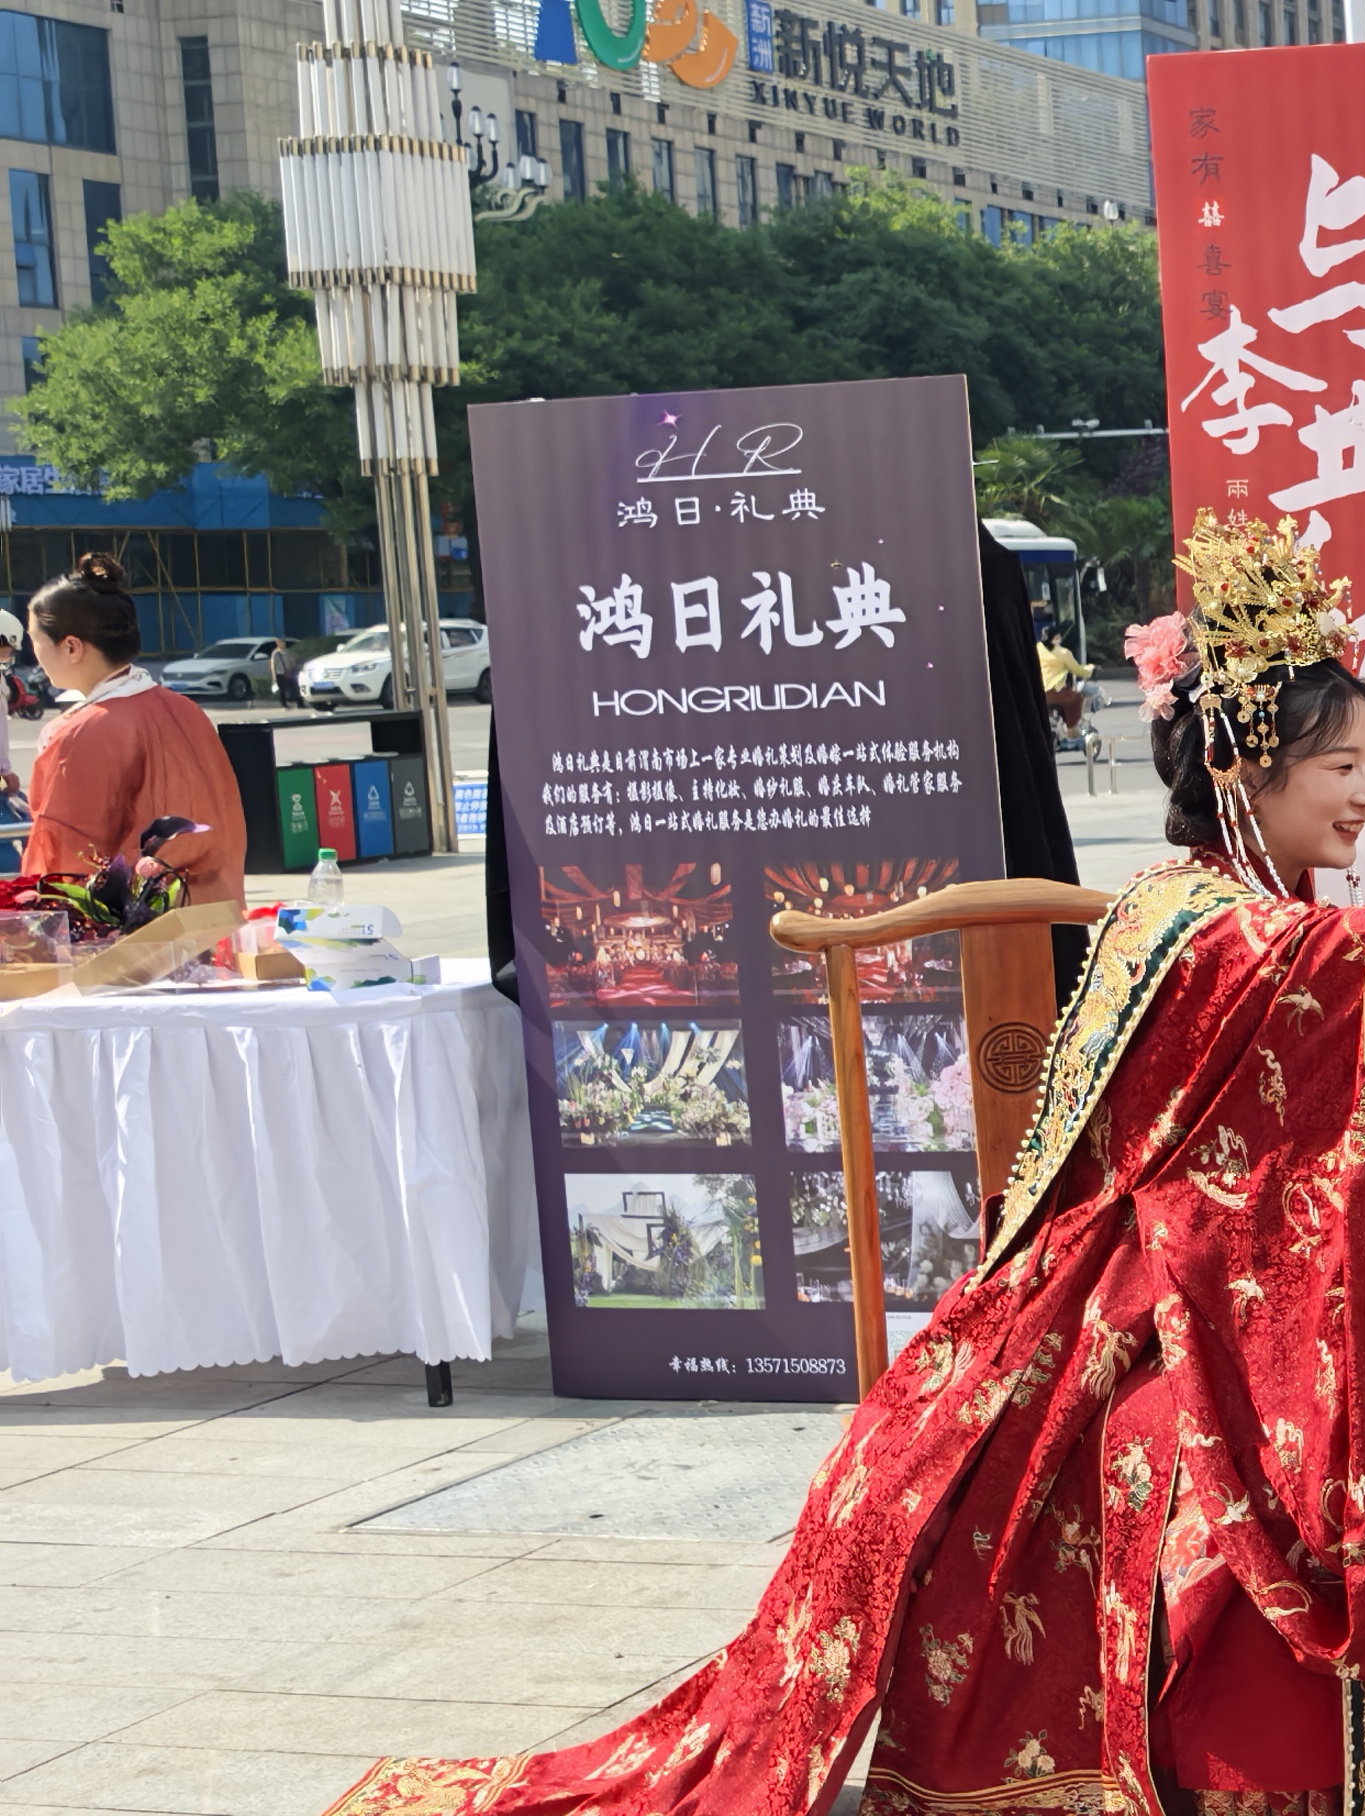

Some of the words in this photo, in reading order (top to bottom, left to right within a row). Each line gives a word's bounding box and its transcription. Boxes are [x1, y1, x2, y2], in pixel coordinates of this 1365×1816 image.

[776, 8, 959, 119] 新悦天地
[750, 79, 855, 125] XINYUE
[867, 106, 961, 148] WORLD
[576, 562, 906, 659] 鸿日礼典
